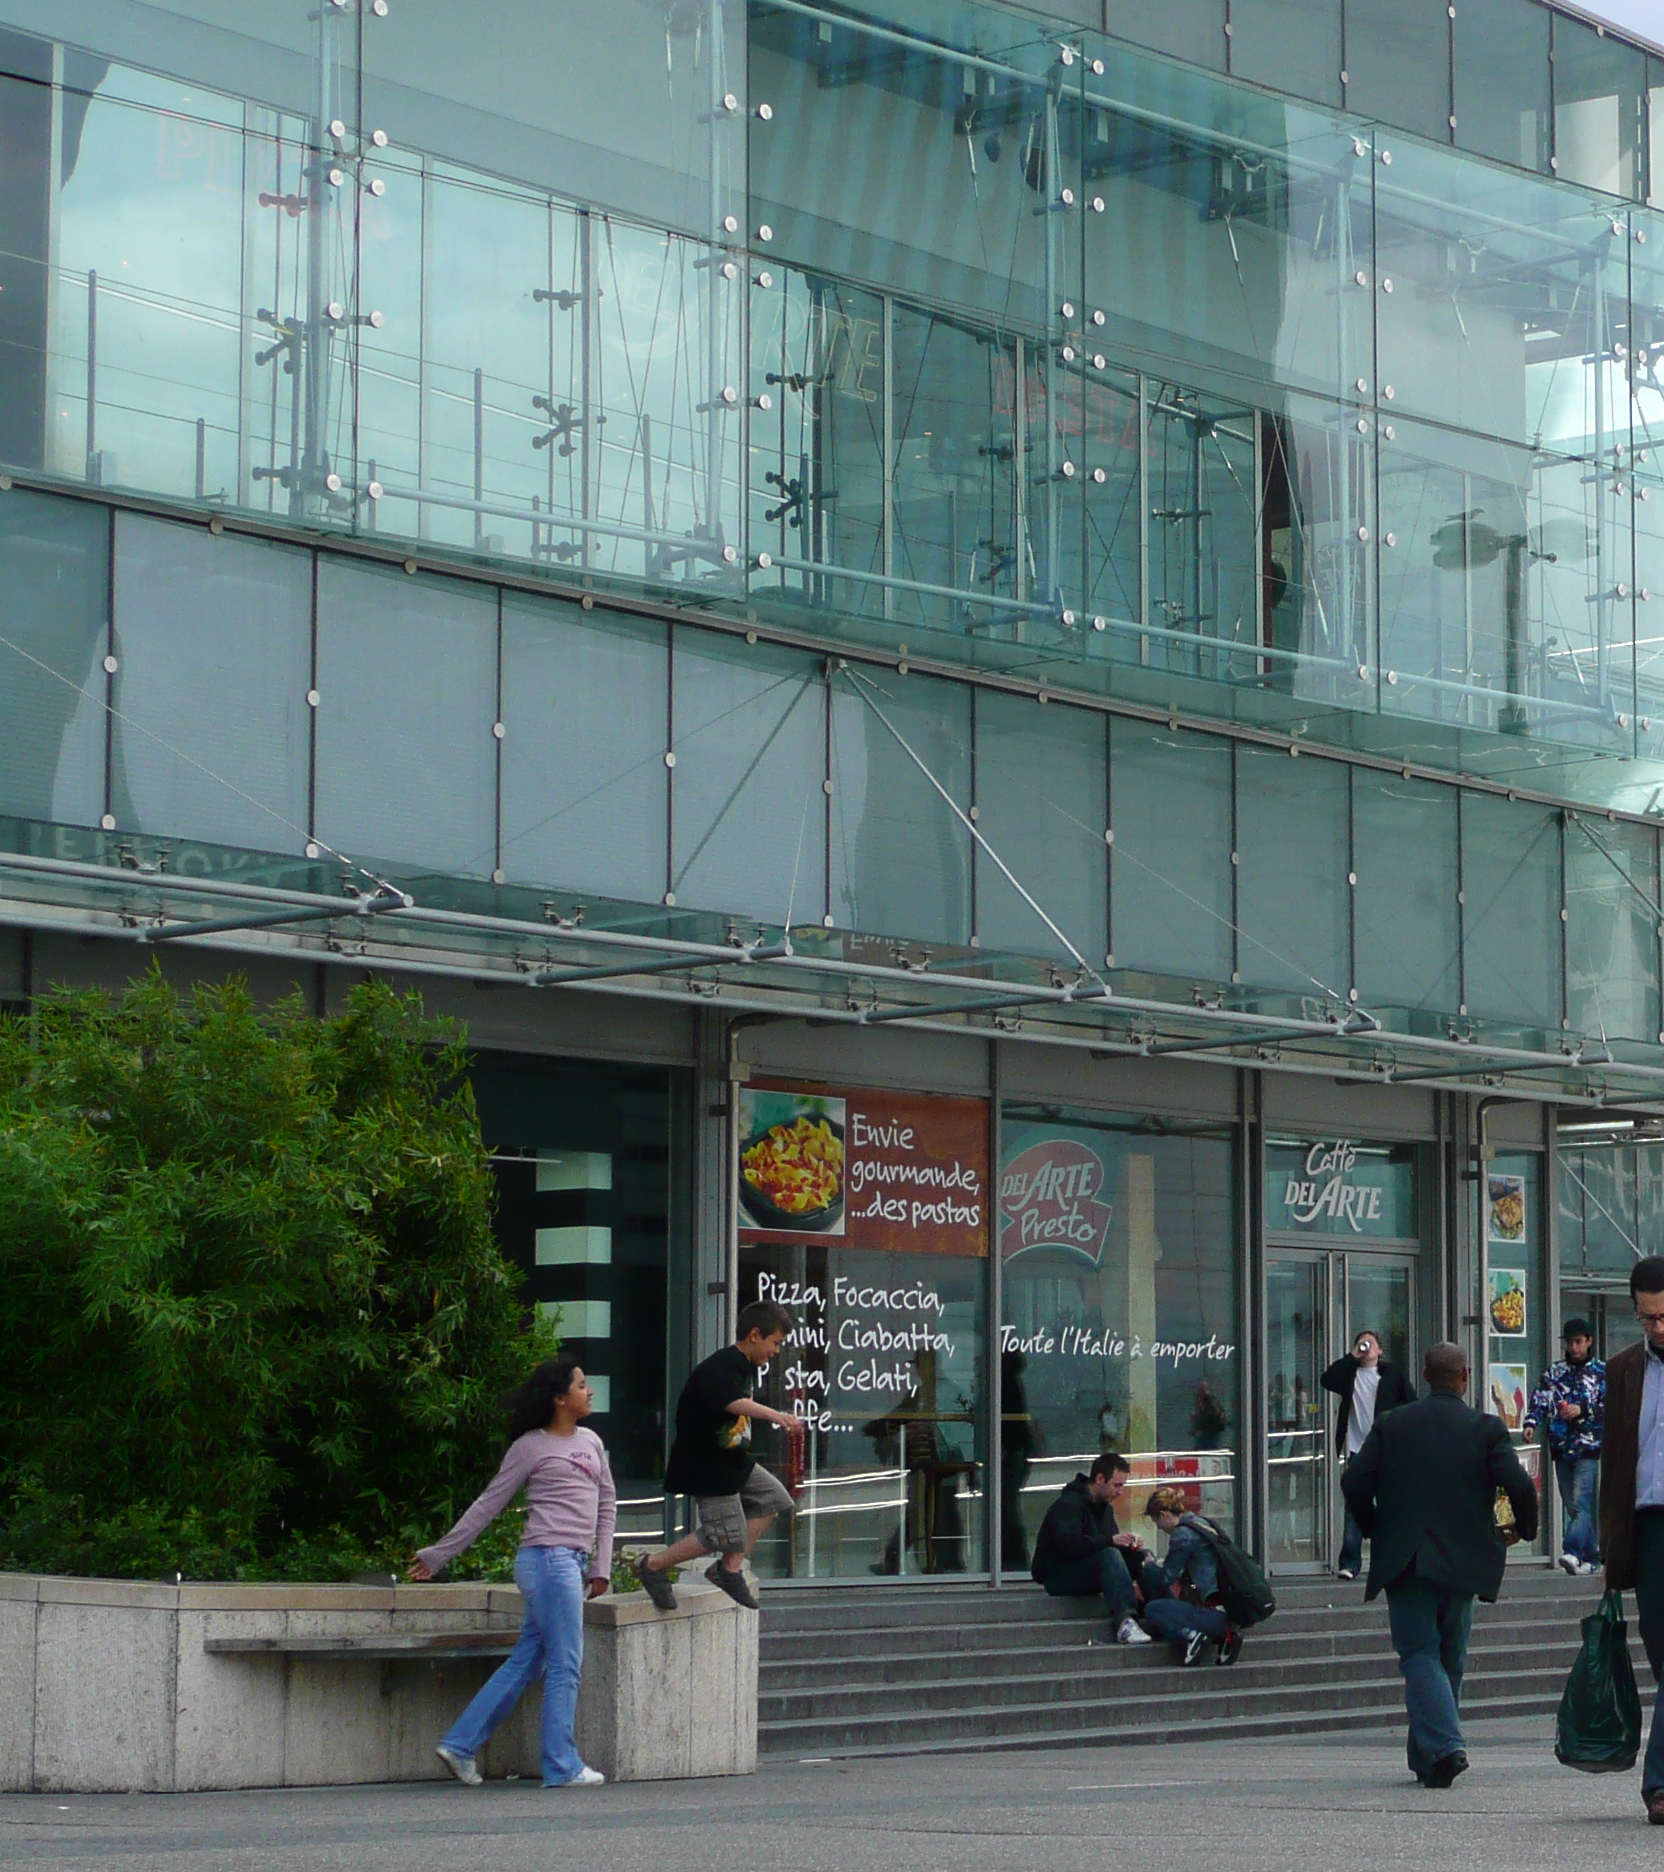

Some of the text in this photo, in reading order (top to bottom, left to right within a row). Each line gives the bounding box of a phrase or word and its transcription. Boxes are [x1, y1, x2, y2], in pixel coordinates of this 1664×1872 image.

[852, 1112, 915, 1150] Envie
[850, 1160, 981, 1197] gourmande,
[1305, 1139, 1358, 1176] Caffè
[1001, 1160, 1096, 1212] DEL ARTE
[1284, 1176, 1382, 1232] DEL ARTE
[911, 1196, 981, 1229] pastas
[1020, 1201, 1098, 1245] Presto
[757, 1271, 946, 1318] Pizza, Focaccia,
[781, 1316, 956, 1358] nini, Ciabatta,
[1000, 1324, 1236, 1368] Toute l'Italie à emporter
[757, 1357, 919, 1398] Psta, Gelati,
